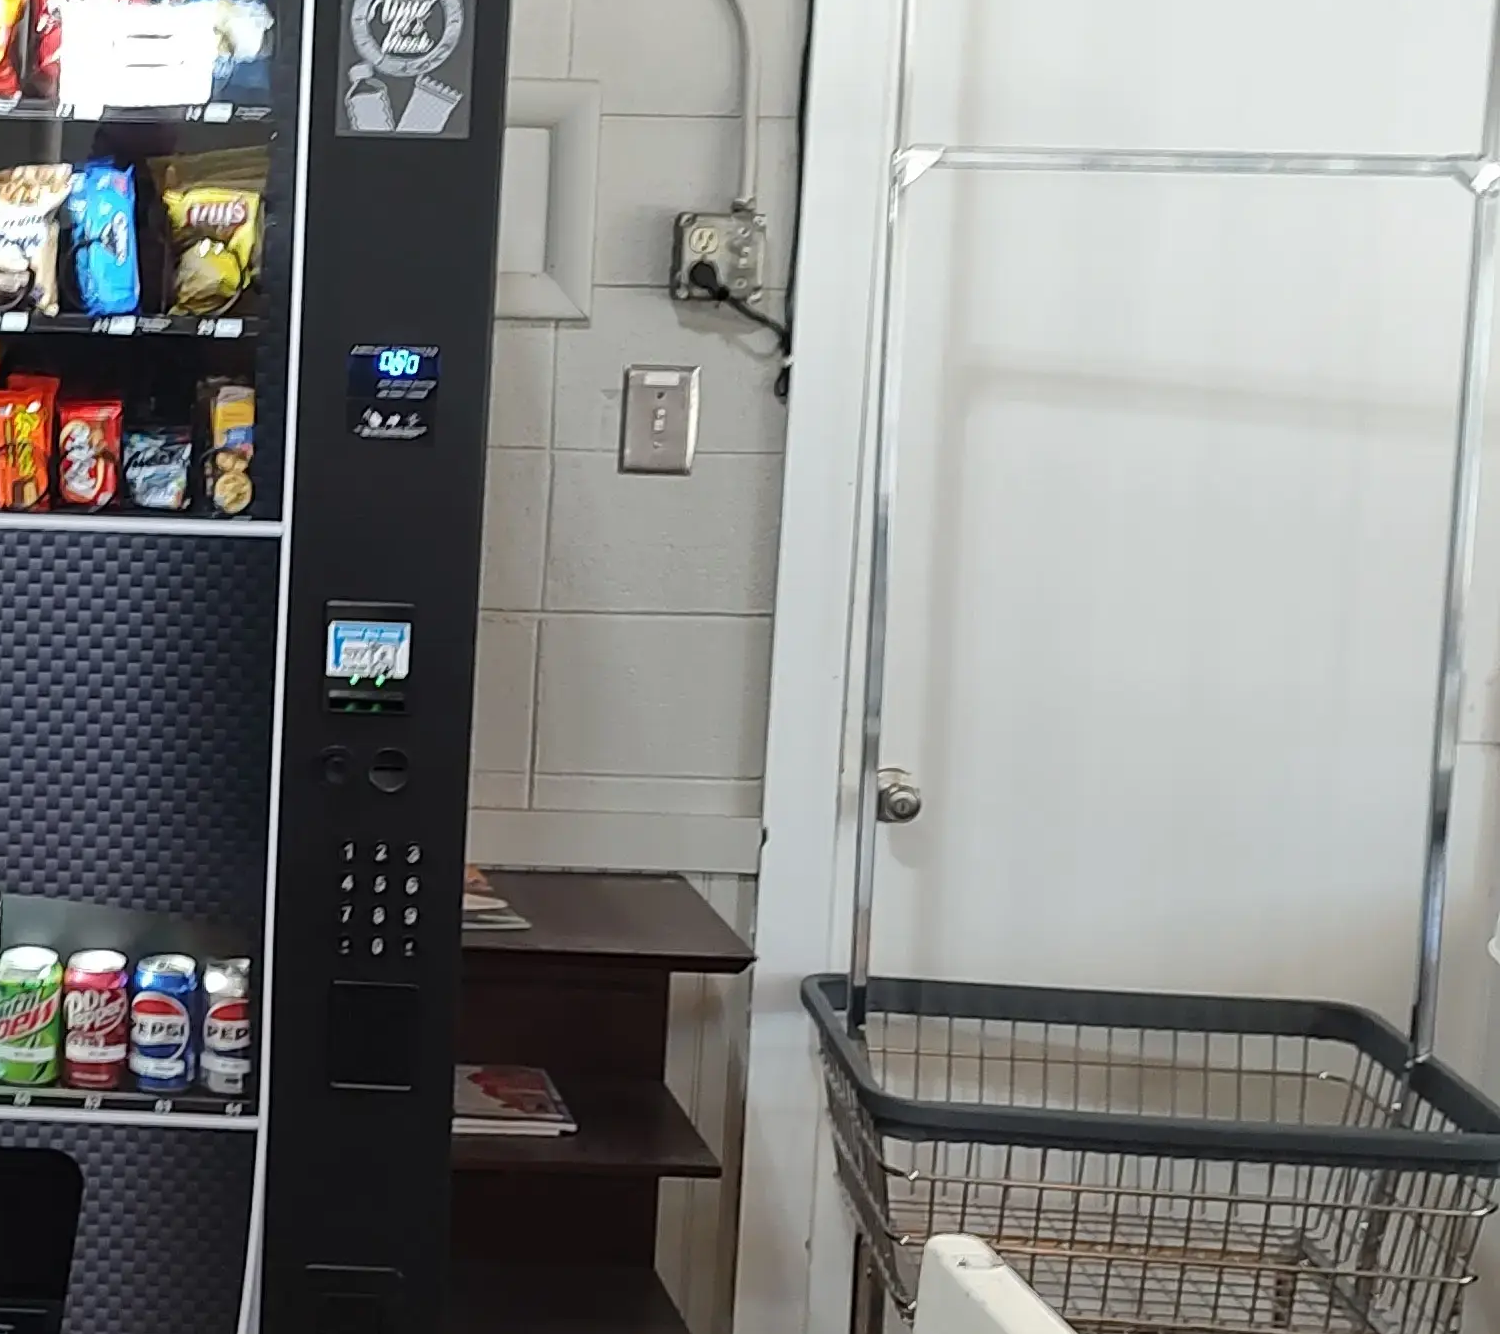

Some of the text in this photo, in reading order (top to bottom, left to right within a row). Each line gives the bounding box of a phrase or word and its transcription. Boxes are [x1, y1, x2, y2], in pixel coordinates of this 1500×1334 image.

[343, 842, 354, 861] 1
[375, 843, 388, 862] 2
[341, 905, 353, 924] 7
[371, 937, 384, 955] 0
[206, 1024, 248, 1041] PEP
